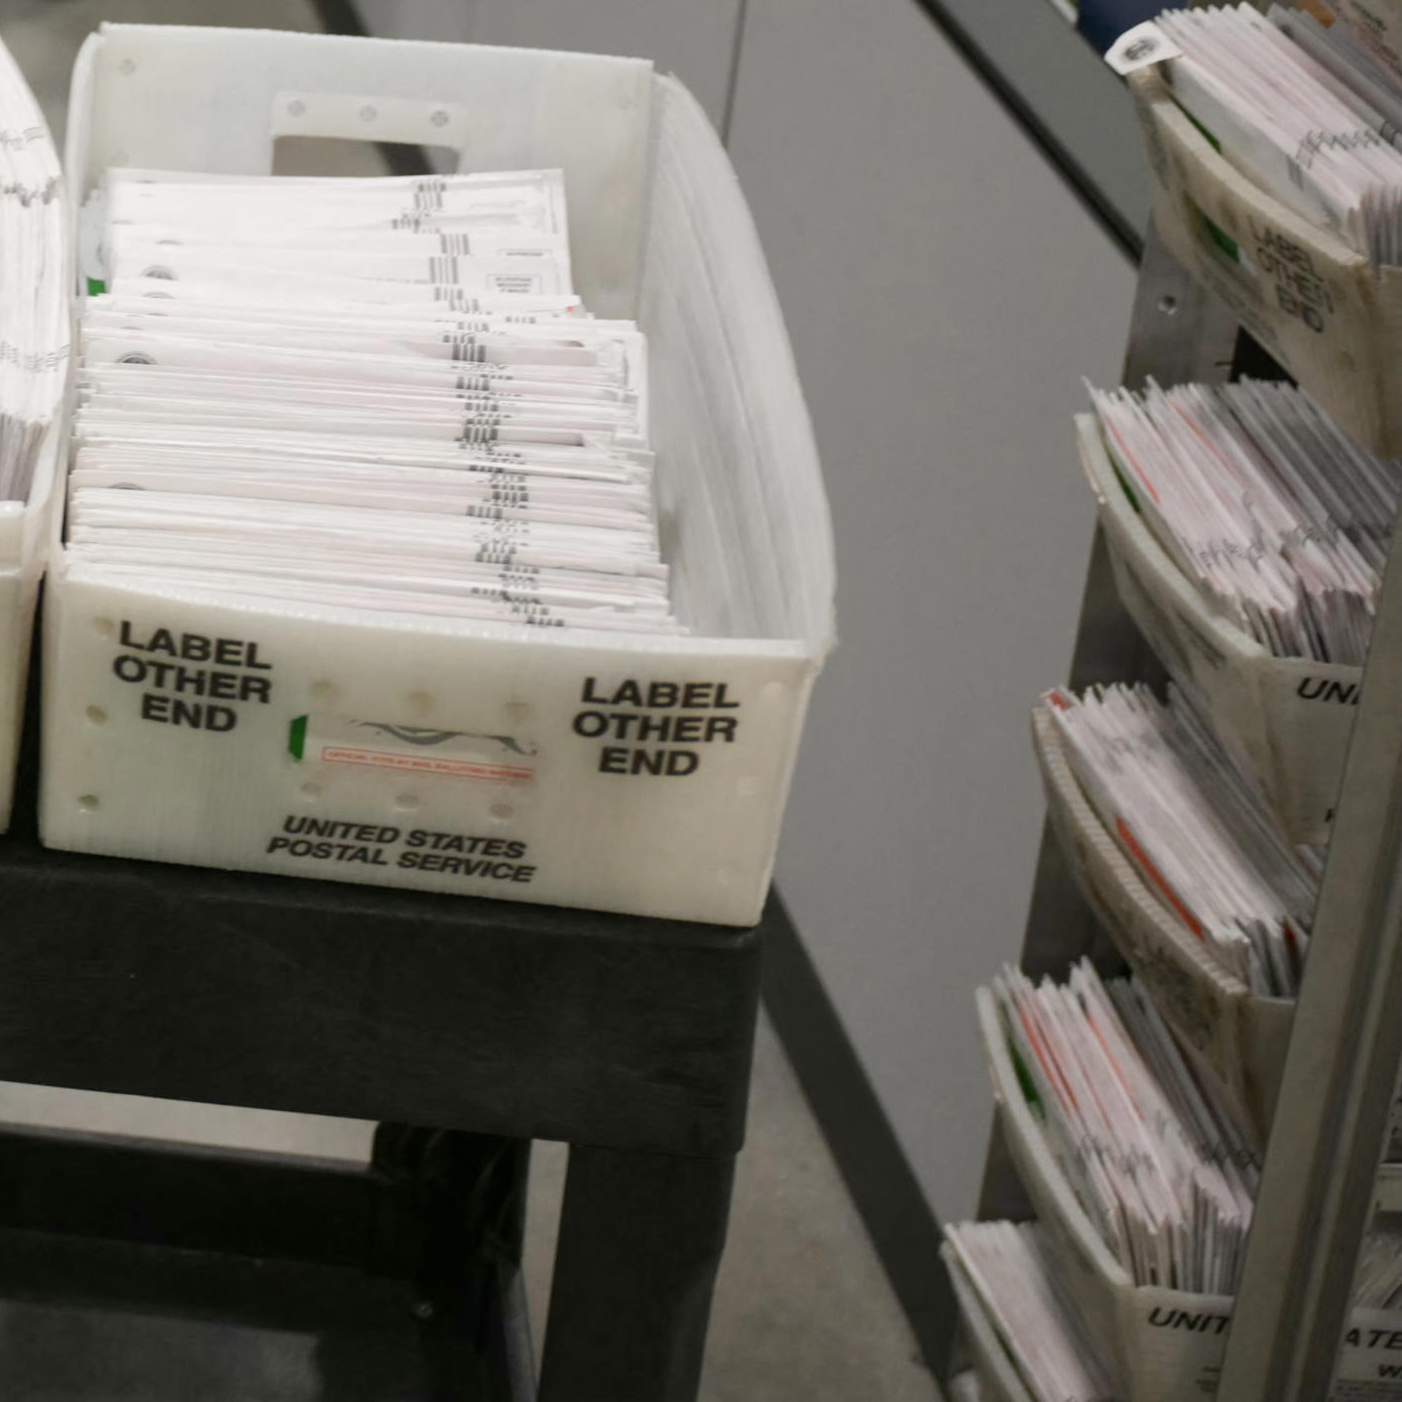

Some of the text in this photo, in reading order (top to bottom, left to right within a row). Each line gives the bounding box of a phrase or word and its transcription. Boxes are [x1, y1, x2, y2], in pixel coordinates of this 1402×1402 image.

[119, 619, 273, 670] LABEL
[112, 654, 273, 704] OTHER
[581, 676, 741, 709] LABEL
[141, 692, 238, 732] END
[572, 710, 739, 743] OTHER
[598, 746, 700, 777] END
[283, 815, 528, 860] UNITED STATES
[266, 837, 538, 884] POSTAL SERVICE
